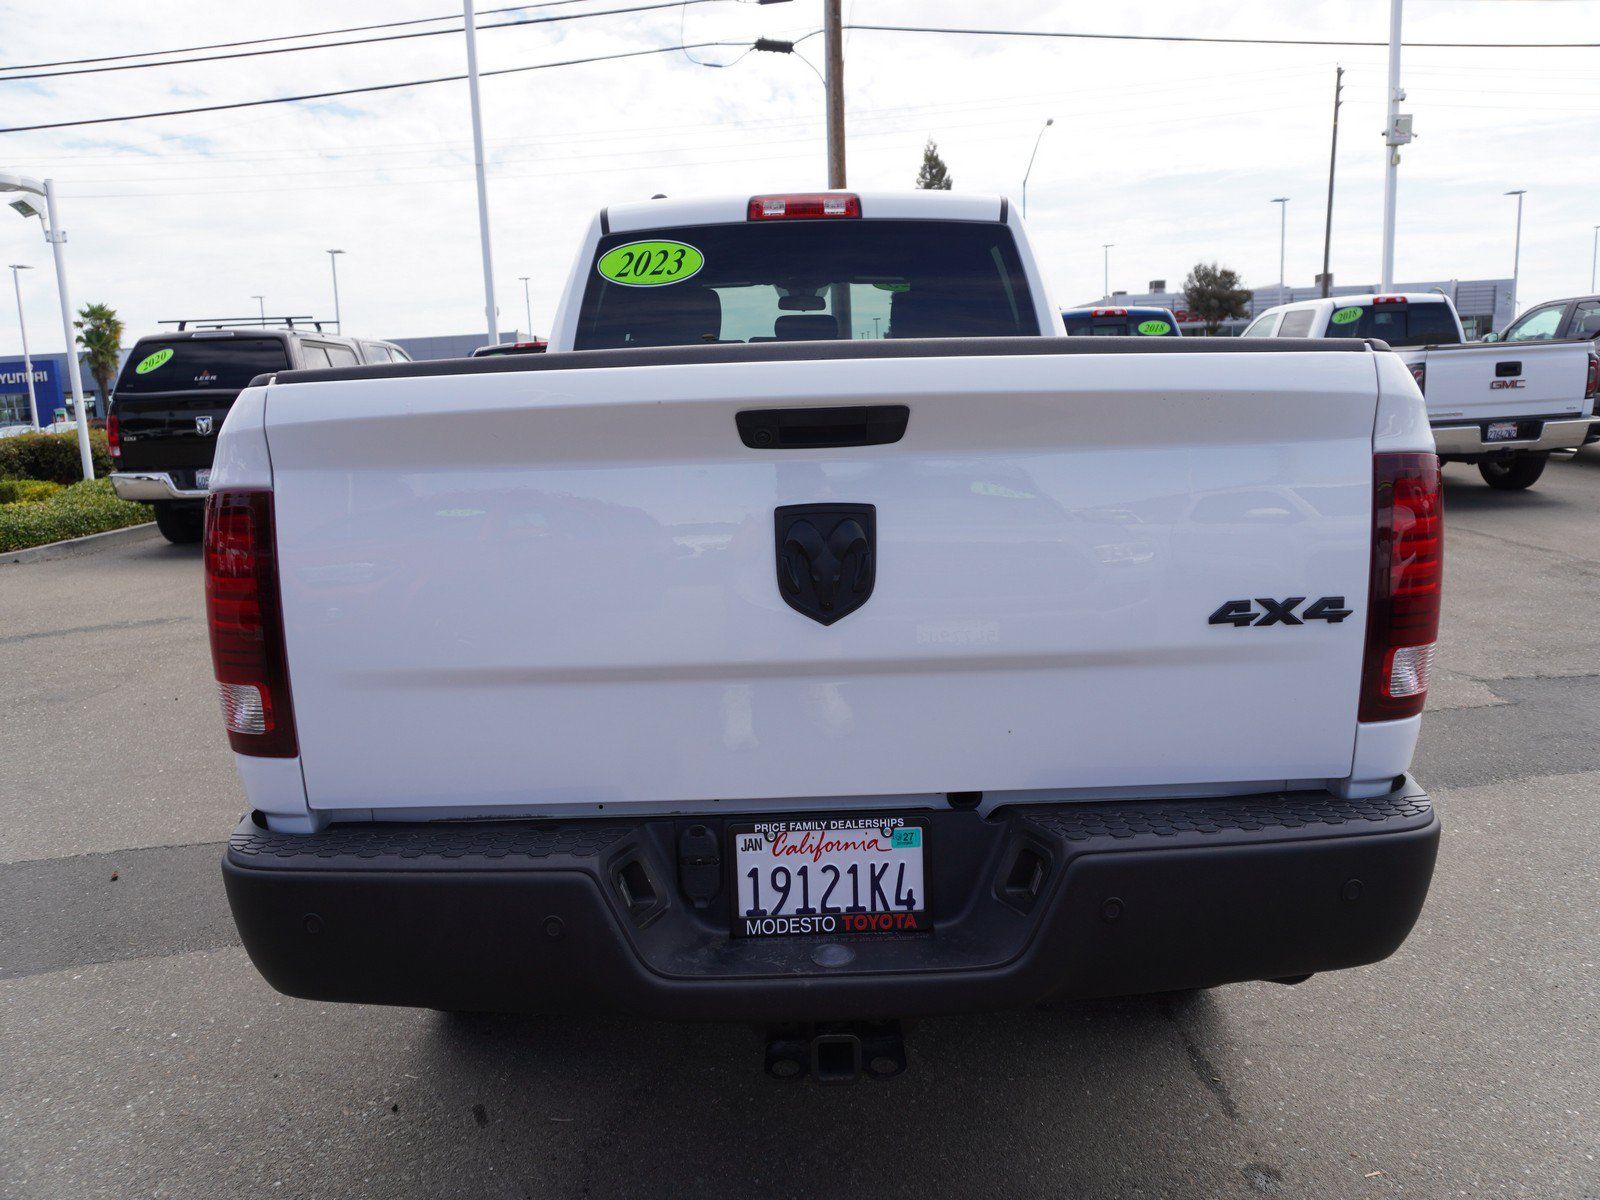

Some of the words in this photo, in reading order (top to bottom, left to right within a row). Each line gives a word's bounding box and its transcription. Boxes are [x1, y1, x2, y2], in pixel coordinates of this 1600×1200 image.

[614, 248, 687, 278] 2023
[1144, 324, 1166, 333] 2018
[143, 352, 168, 371] 2020
[0, 370, 48, 384] YUNAI
[1490, 379, 1526, 390] GMC
[1208, 596, 1354, 627] 4X4
[754, 822, 787, 833] PRICE
[789, 820, 827, 831] FAMILY
[830, 817, 905, 830] DEALERSHIPS
[740, 837, 763, 852] JAN
[903, 832, 914, 842] 27
[771, 831, 892, 862] California
[745, 862, 917, 917] 19121K4
[746, 916, 836, 935] MODESTO
[842, 914, 917, 931] TOYOTA
